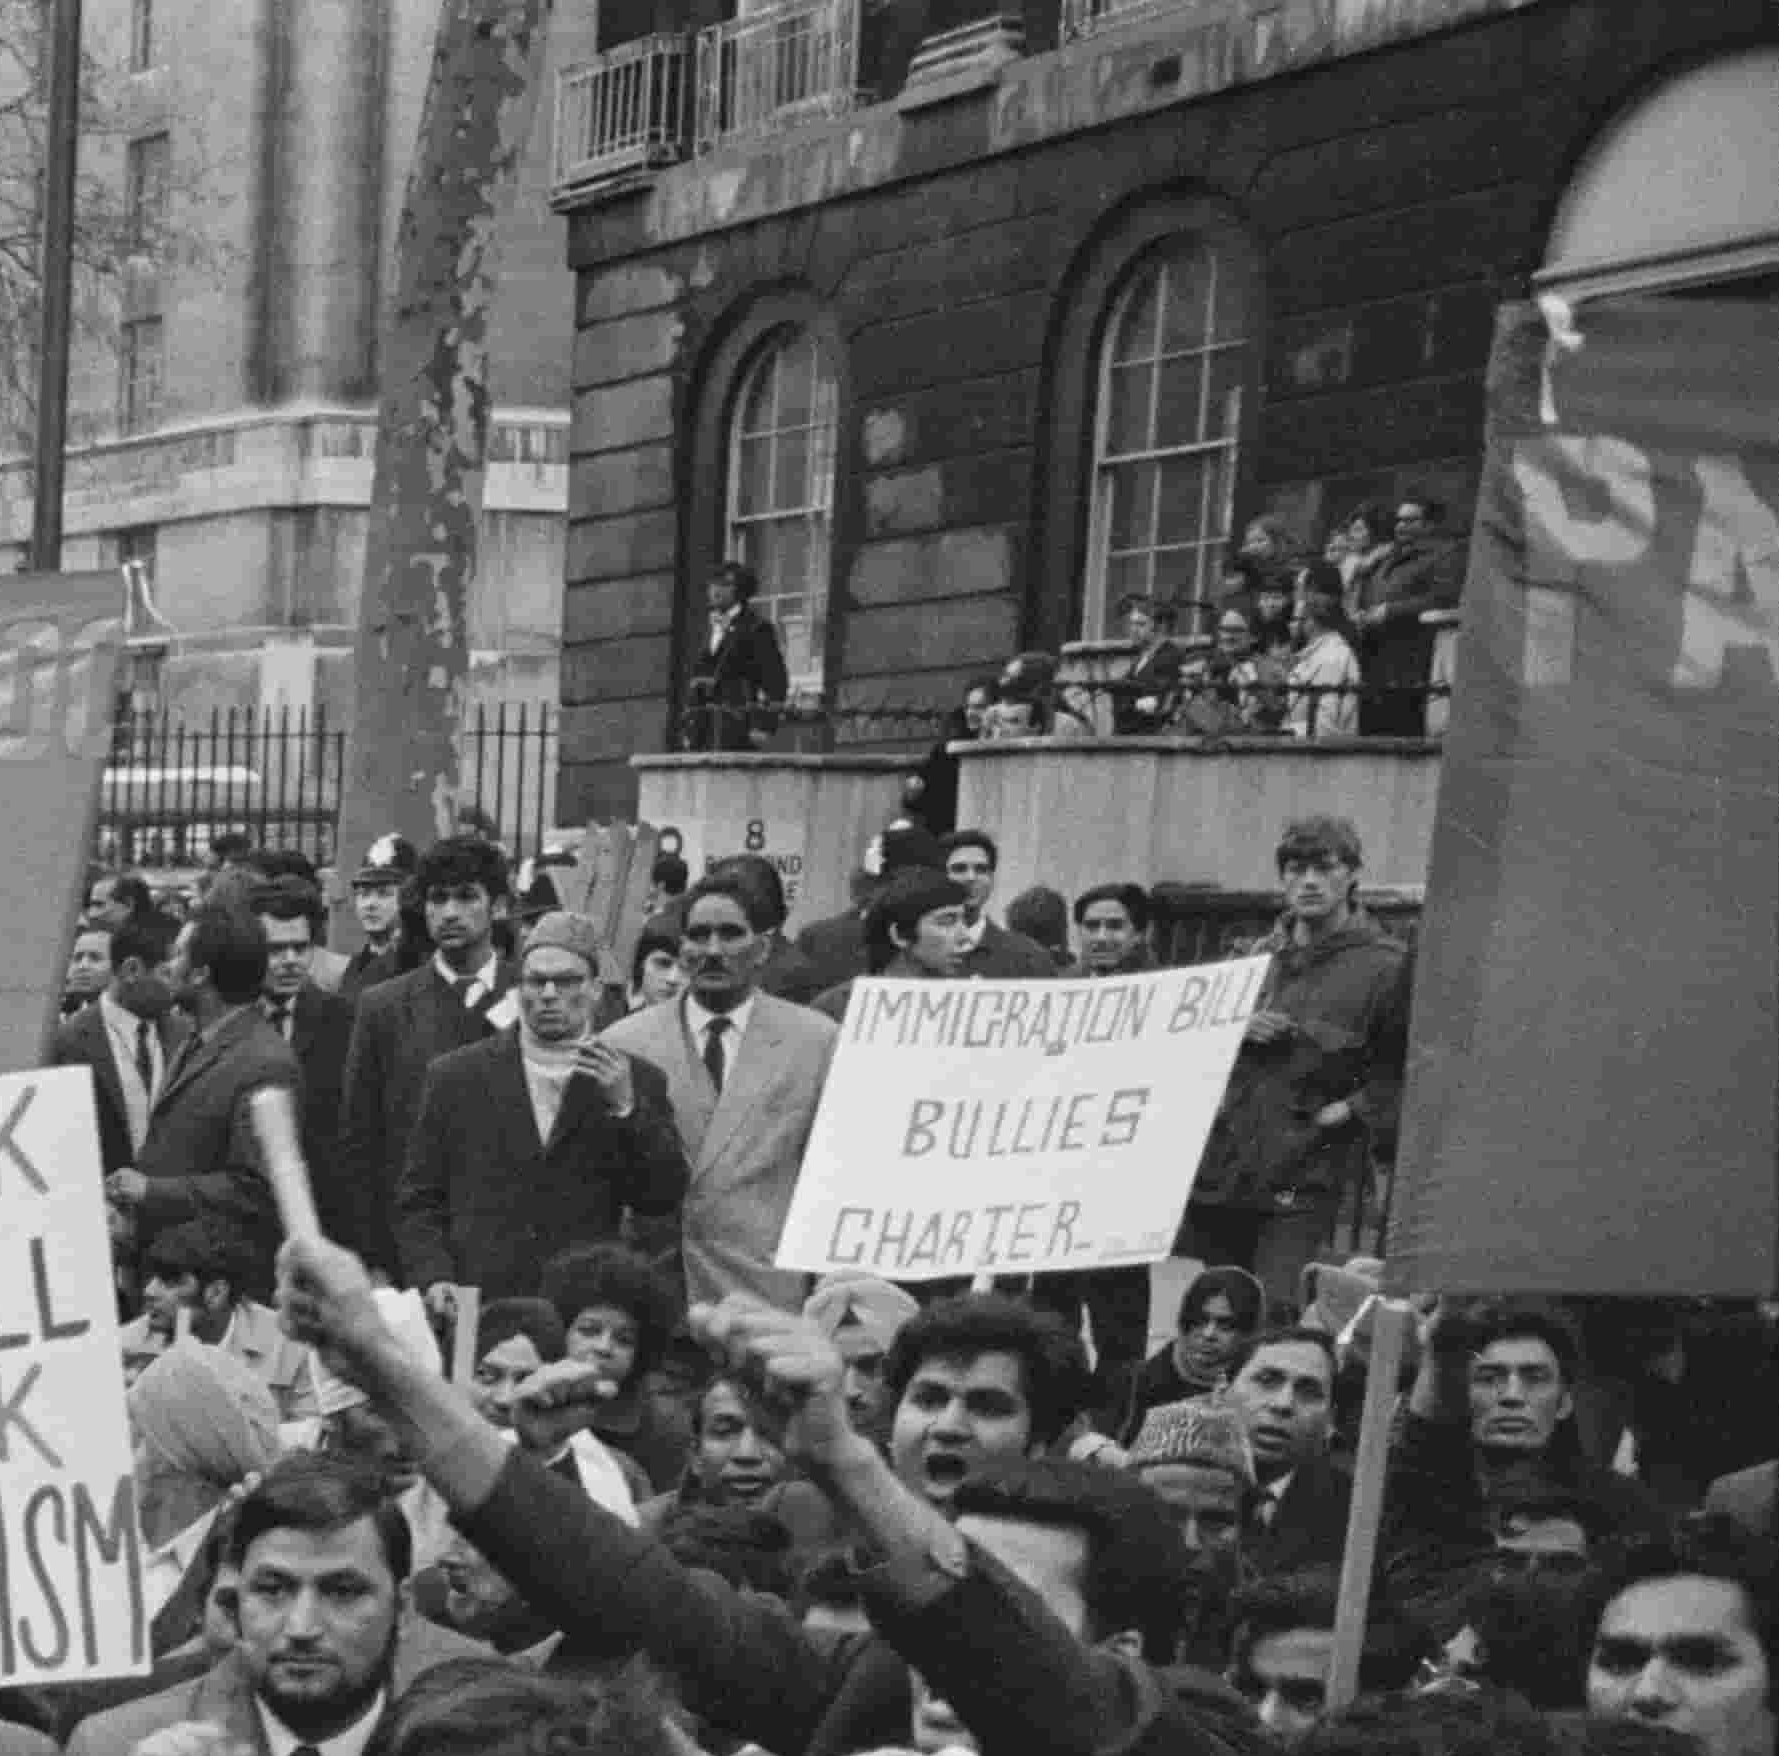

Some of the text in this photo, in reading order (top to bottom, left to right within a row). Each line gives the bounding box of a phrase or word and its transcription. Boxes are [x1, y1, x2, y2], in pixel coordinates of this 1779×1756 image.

[745, 819, 766, 851] 8
[851, 966, 1259, 1056] IMMIGRATION BILL
[902, 1087, 1151, 1159] BULLIES
